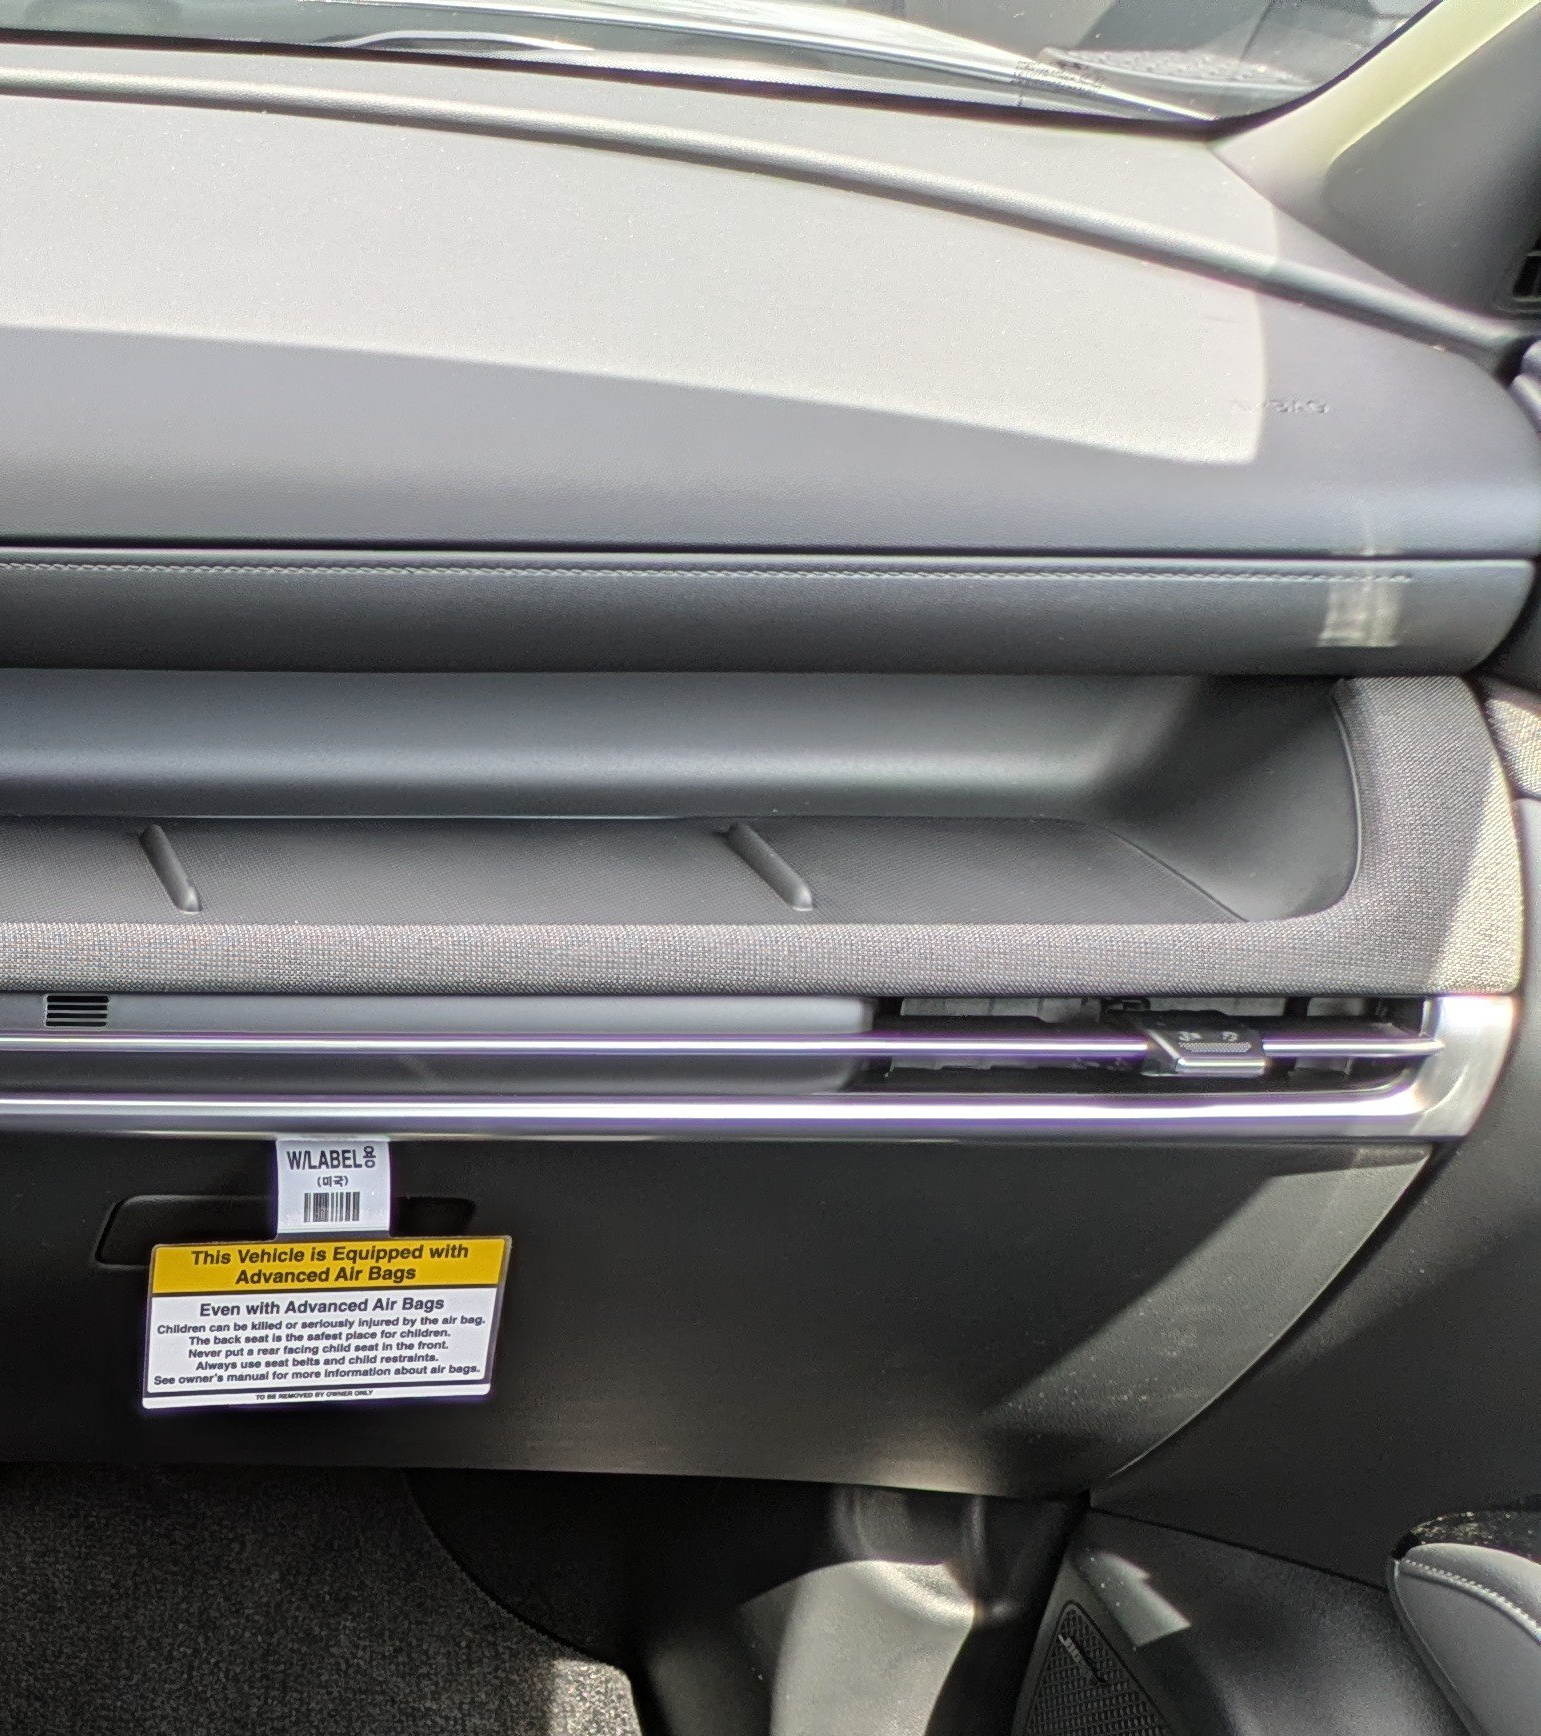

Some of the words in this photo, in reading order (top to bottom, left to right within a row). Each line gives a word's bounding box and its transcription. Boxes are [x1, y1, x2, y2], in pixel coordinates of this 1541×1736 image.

[191, 1250, 231, 1266] This
[237, 1247, 305, 1265] Vehicle
[310, 1247, 327, 1262] is
[332, 1245, 424, 1264] Equipped
[429, 1244, 469, 1259] with
[235, 1267, 330, 1285] Advanced
[334, 1266, 363, 1282] Air
[368, 1265, 417, 1284] Bags
[200, 1302, 240, 1317] Even
[245, 1300, 280, 1315] with
[284, 1298, 368, 1315] Advanced
[372, 1297, 398, 1311] Air
[402, 1297, 445, 1313] Bags
[157, 1324, 205, 1334] Children
[209, 1325, 231, 1333] can
[233, 1322, 248, 1332] be
[251, 1320, 282, 1331] killed
[285, 1321, 298, 1329] or
[301, 1318, 355, 1330] seriously
[358, 1317, 399, 1329] injured
[402, 1317, 417, 1328] by
[420, 1316, 439, 1325] the
[441, 1315, 457, 1325] air
[460, 1315, 486, 1326] bag.
[189, 1336, 211, 1346] The
[213, 1335, 241, 1345] back
[244, 1334, 269, 1344] seat
[271, 1333, 282, 1343] is
[285, 1332, 304, 1342] the
[306, 1331, 343, 1341] safest
[345, 1331, 377, 1342] place
[380, 1329, 397, 1339] for
[399, 1328, 451, 1338] children.
[188, 1349, 222, 1359] Never
[225, 1348, 244, 1359] put
[247, 1348, 254, 1356] a
[257, 1347, 280, 1356] rear
[283, 1345, 319, 1356] facing
[322, 1343, 351, 1353] child
[354, 1342, 379, 1352] seat
[382, 1342, 393, 1351] in
[396, 1341, 415, 1350] the
[417, 1340, 449, 1349] front.
[195, 1361, 237, 1372] Always
[240, 1360, 262, 1368] use
[265, 1358, 289, 1367] seat
[292, 1357, 321, 1366] belts
[323, 1355, 346, 1365] and
[348, 1354, 377, 1364] child
[380, 1353, 439, 1363] restraints.
[154, 1376, 175, 1385] See
[178, 1373, 224, 1383] owner's
[227, 1371, 269, 1382] manual
[272, 1370, 289, 1380] for
[292, 1370, 321, 1379] more
[324, 1367, 391, 1378] information
[394, 1365, 427, 1375] about
[430, 1364, 445, 1374] air
[448, 1364, 480, 1375] bags.
